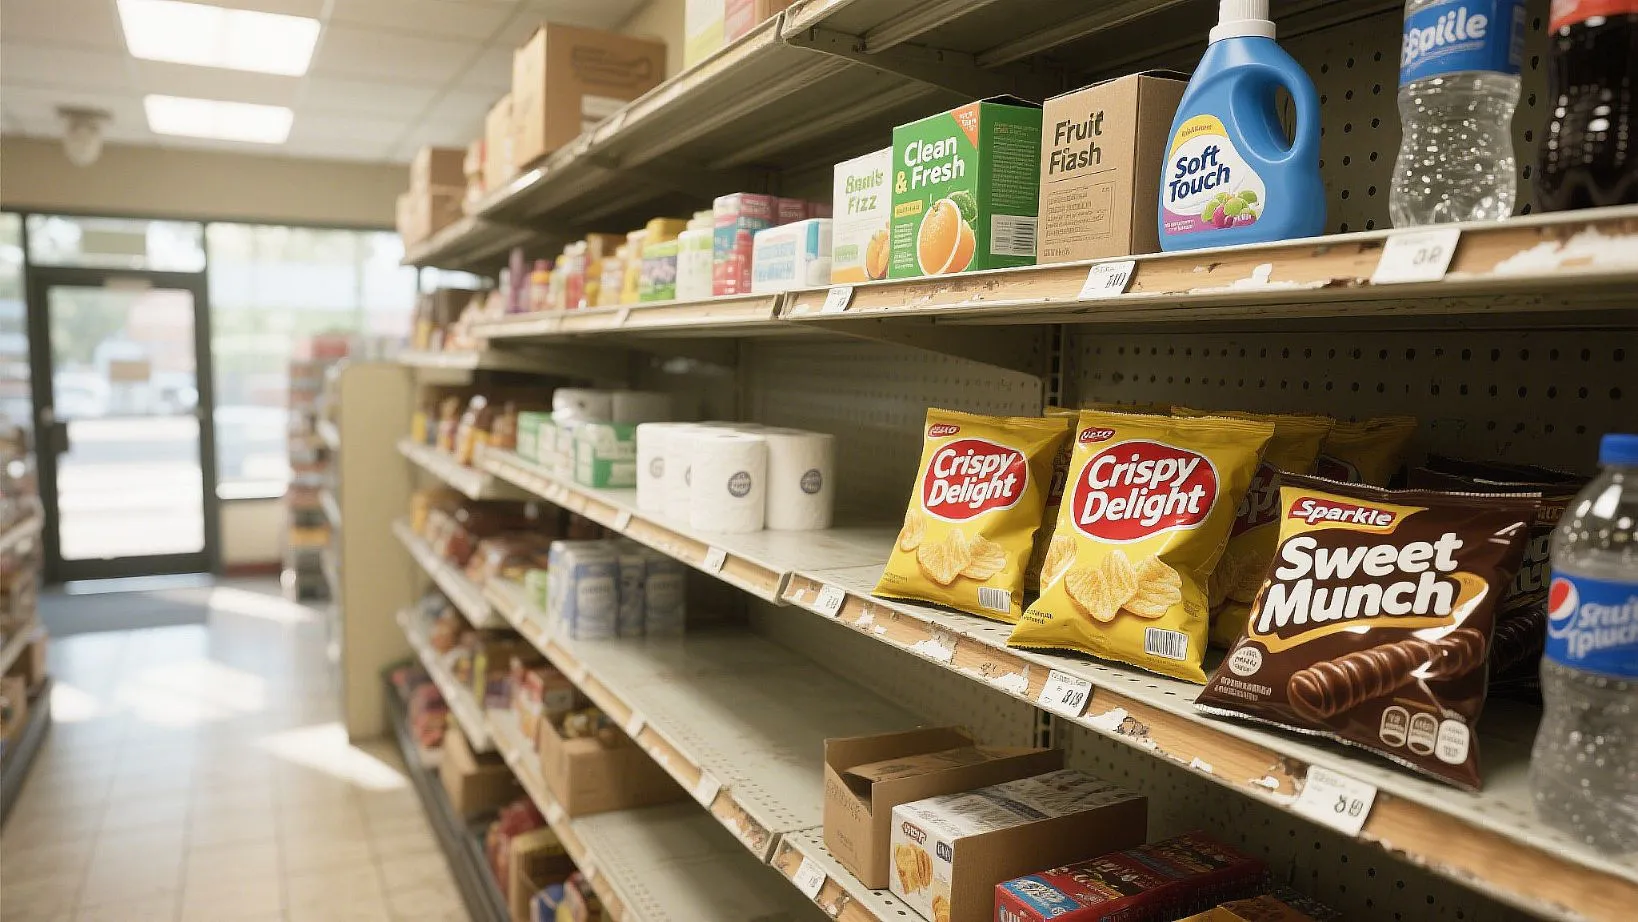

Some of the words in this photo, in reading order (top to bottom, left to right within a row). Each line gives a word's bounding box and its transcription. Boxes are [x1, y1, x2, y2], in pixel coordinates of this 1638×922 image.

[1055, 110, 1104, 146] Fruit
[904, 136, 957, 167] Clean
[1175, 145, 1220, 178] Soft
[895, 171, 908, 194] &
[911, 155, 965, 189] Fresh
[1169, 163, 1231, 202] Touch
[933, 449, 1016, 480] Crispy
[1087, 454, 1200, 490] Crispy
[927, 472, 1017, 509] Delight
[1080, 484, 1206, 527] Delight
[1292, 500, 1392, 526] Sparkle
[1275, 532, 1464, 581] Sweet
[1257, 571, 1454, 634] Munch
